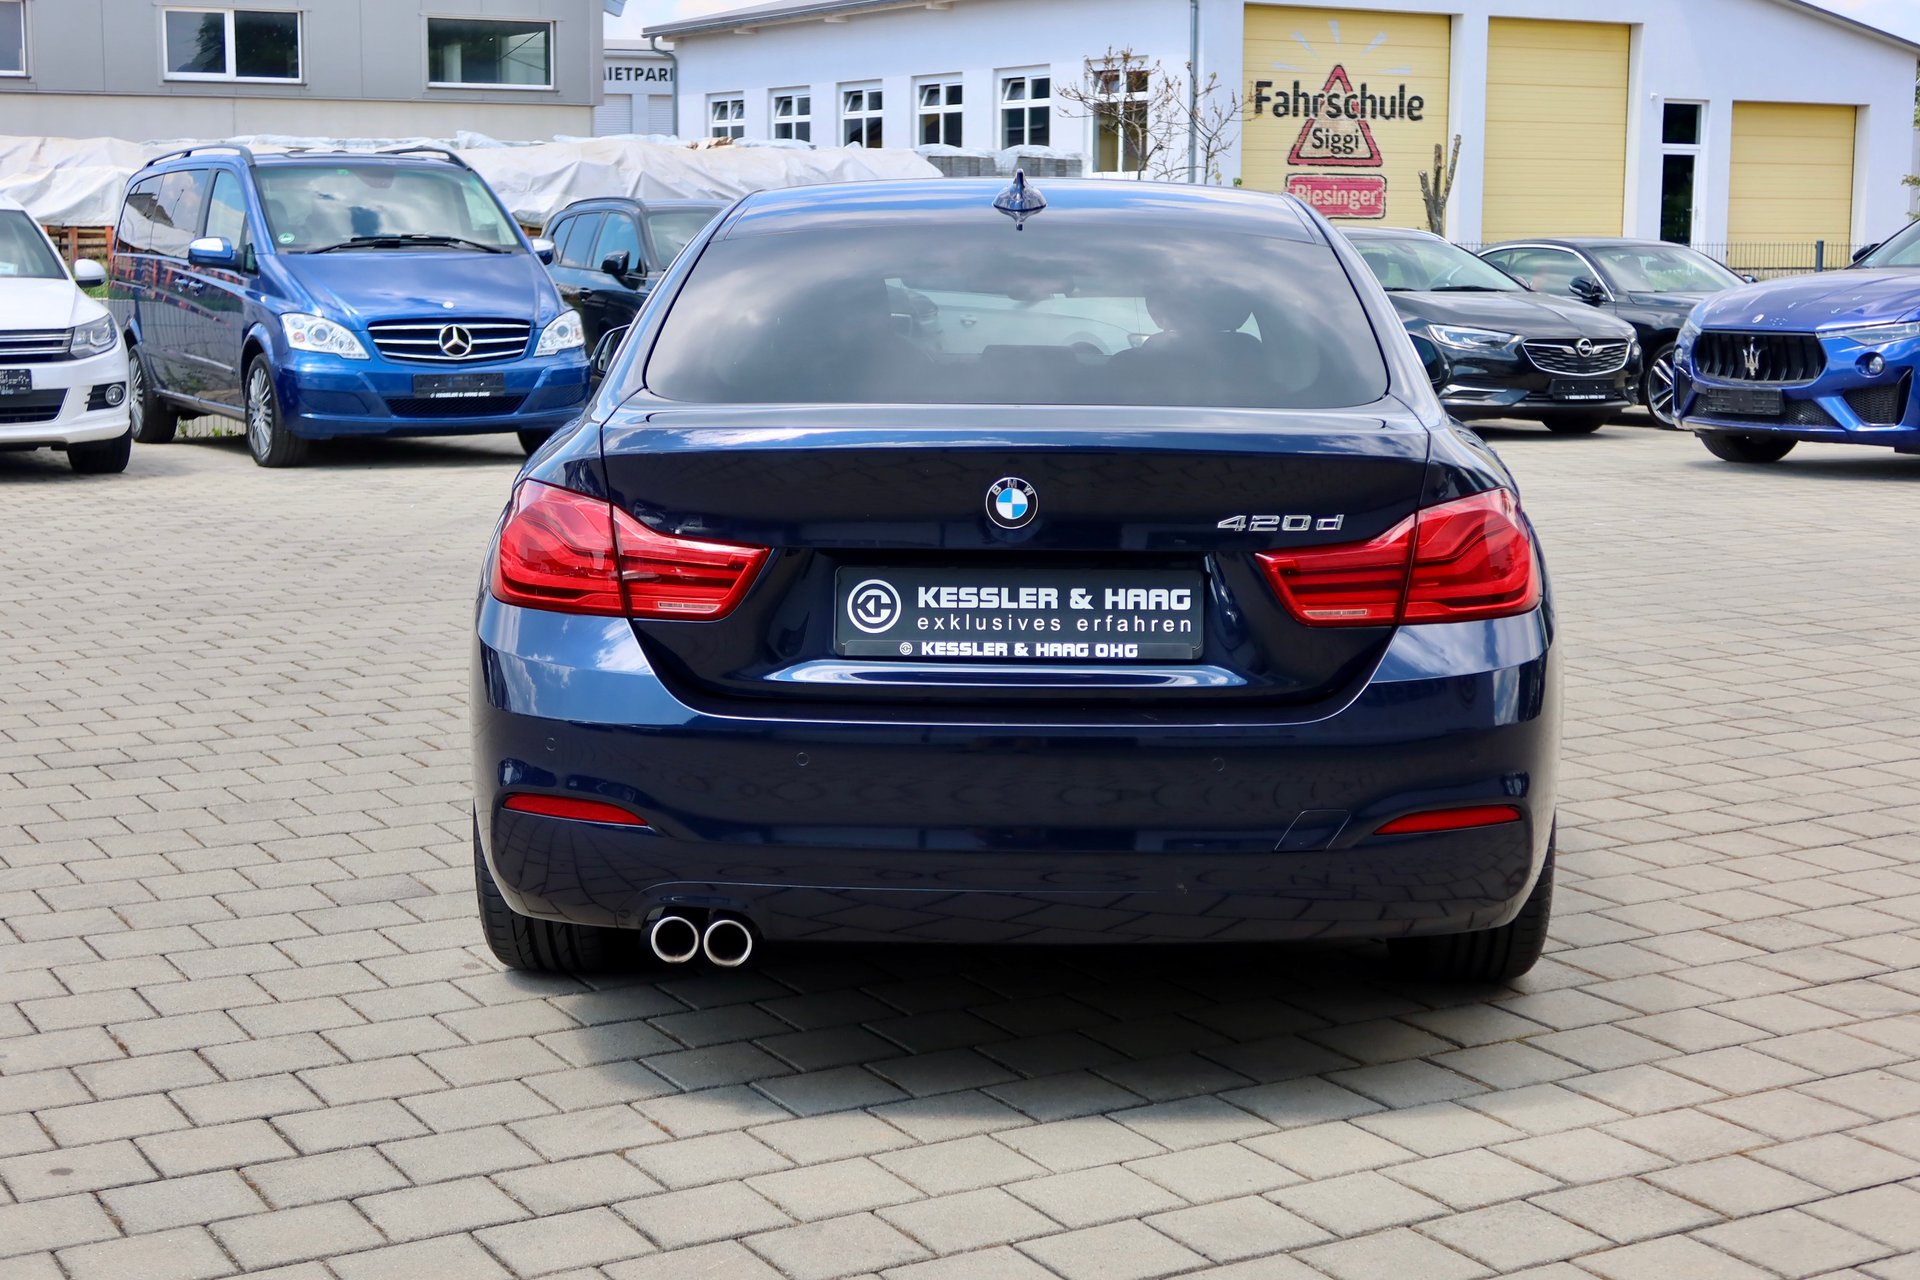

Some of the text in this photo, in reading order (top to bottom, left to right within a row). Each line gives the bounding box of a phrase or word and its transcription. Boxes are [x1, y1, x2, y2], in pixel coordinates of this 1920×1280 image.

[1254, 80, 1424, 121] Fahrschule
[1311, 127, 1359, 154] Siggi
[992, 479, 1034, 496] BMW
[1217, 514, 1345, 532] 420d
[917, 586, 1191, 611] KESSLER & HAAG
[917, 613, 1192, 633] exklusives erfahren
[921, 642, 1138, 658] KESSLER & HAAG OHG
